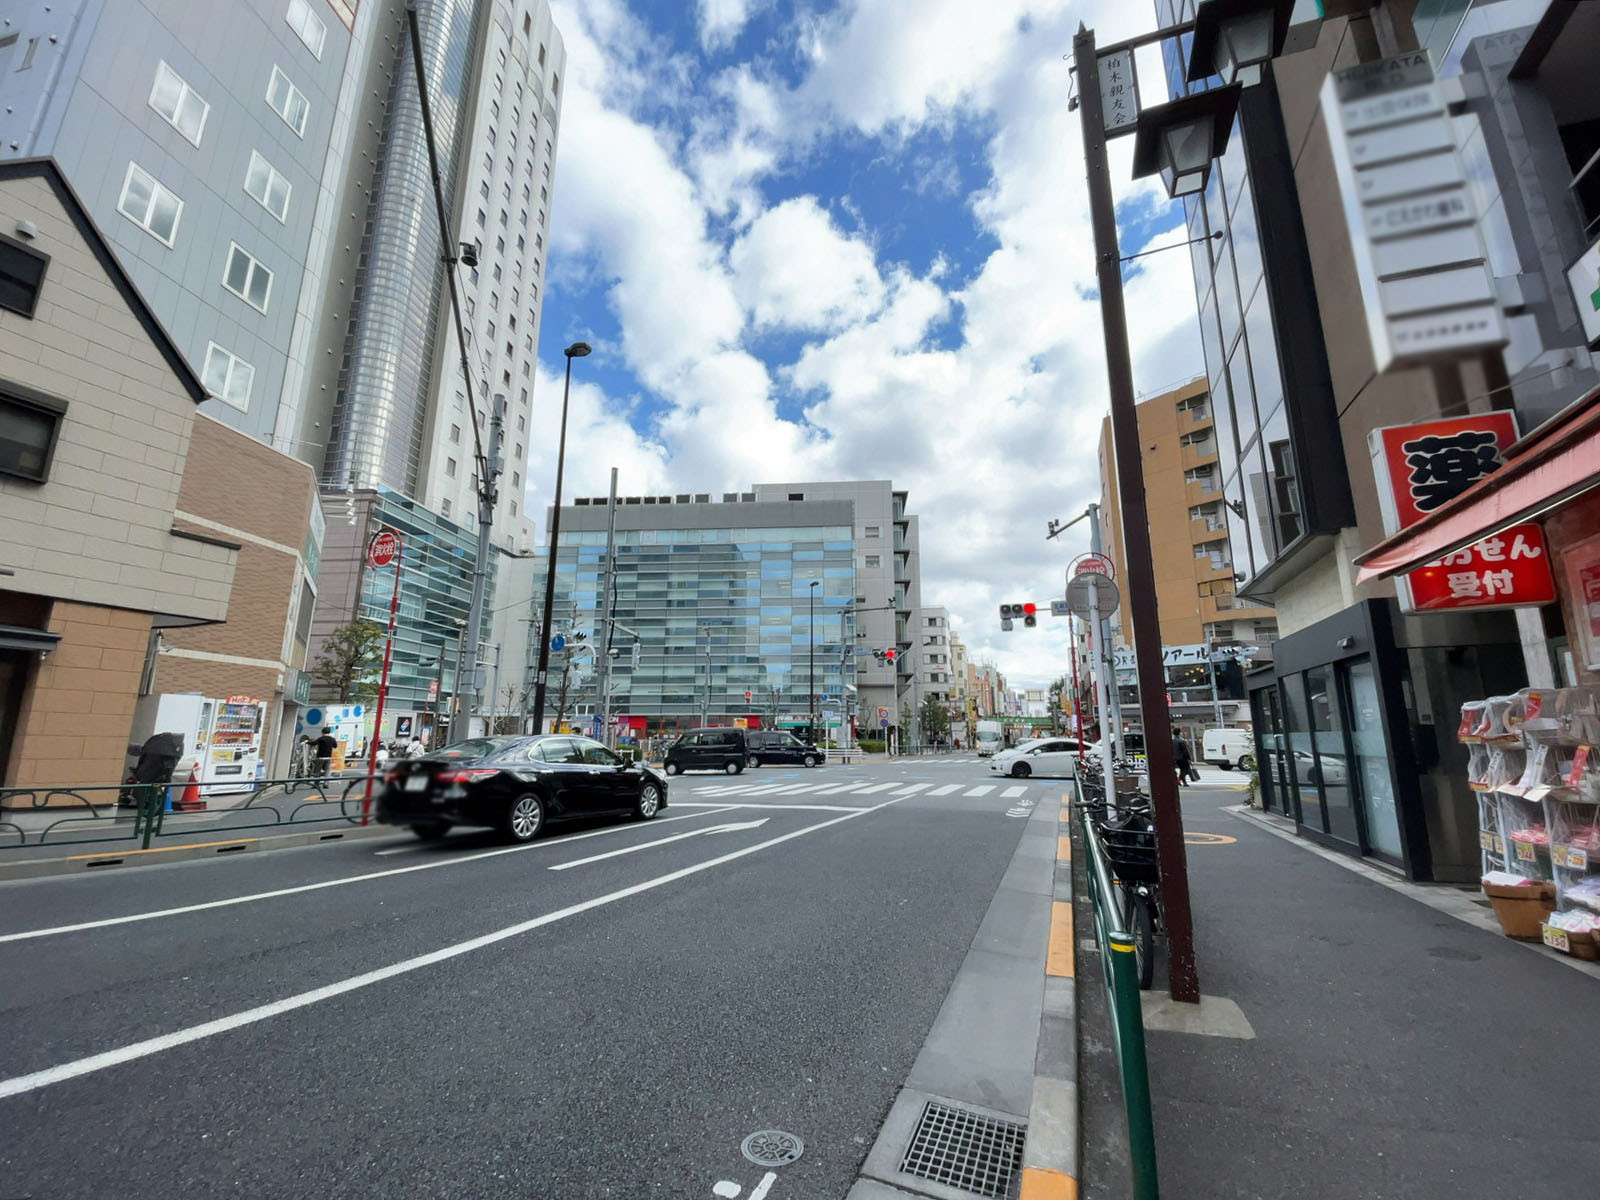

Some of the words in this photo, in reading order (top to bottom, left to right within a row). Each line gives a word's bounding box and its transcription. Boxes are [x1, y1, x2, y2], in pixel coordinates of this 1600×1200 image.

[1107, 59, 1126, 125] 柏木親友会
[1447, 569, 1513, 598] 受付
